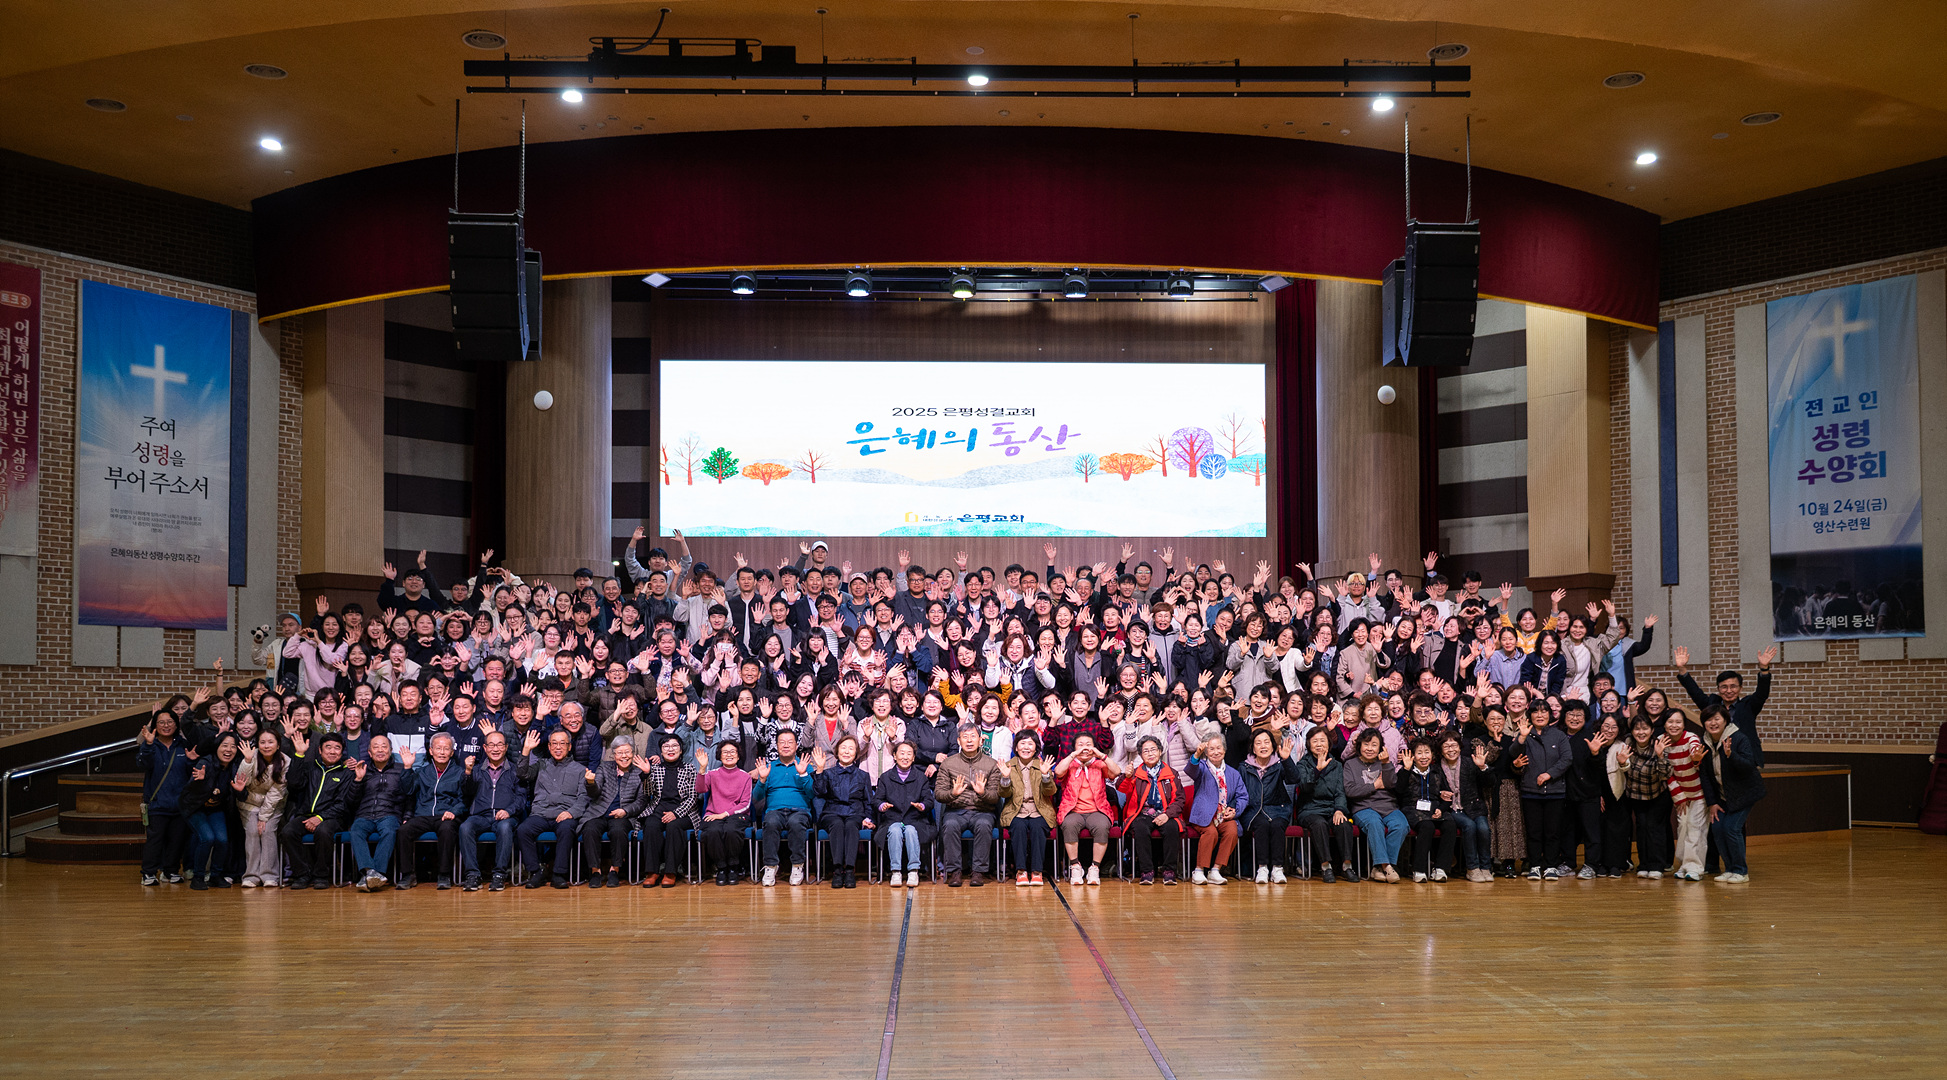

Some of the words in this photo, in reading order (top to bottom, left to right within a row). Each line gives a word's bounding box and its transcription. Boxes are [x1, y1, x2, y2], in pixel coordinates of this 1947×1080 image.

[14, 319, 30, 370] 어떻게
[13, 373, 30, 406] 하면
[11, 410, 29, 444] 남은
[141, 415, 176, 440] 주여
[892, 407, 938, 417] 2025
[943, 407, 1036, 417] 은평성결교회
[846, 421, 978, 456] 은혜의
[989, 421, 1081, 457] 동산
[1812, 419, 1871, 452] 성령
[11, 447, 28, 482] 삶을
[132, 441, 186, 468] 성령을
[1797, 450, 1886, 485] 수양회
[104, 466, 145, 493] 부어
[149, 472, 208, 500] 주소서
[956, 513, 1024, 523] 은평교회
[1798, 502, 1829, 516] 10월
[1833, 498, 1888, 514] 24일(금)
[1813, 517, 1870, 534] 영산수련원
[1814, 615, 1848, 629] 은혜의
[1851, 614, 1875, 628] 동산
